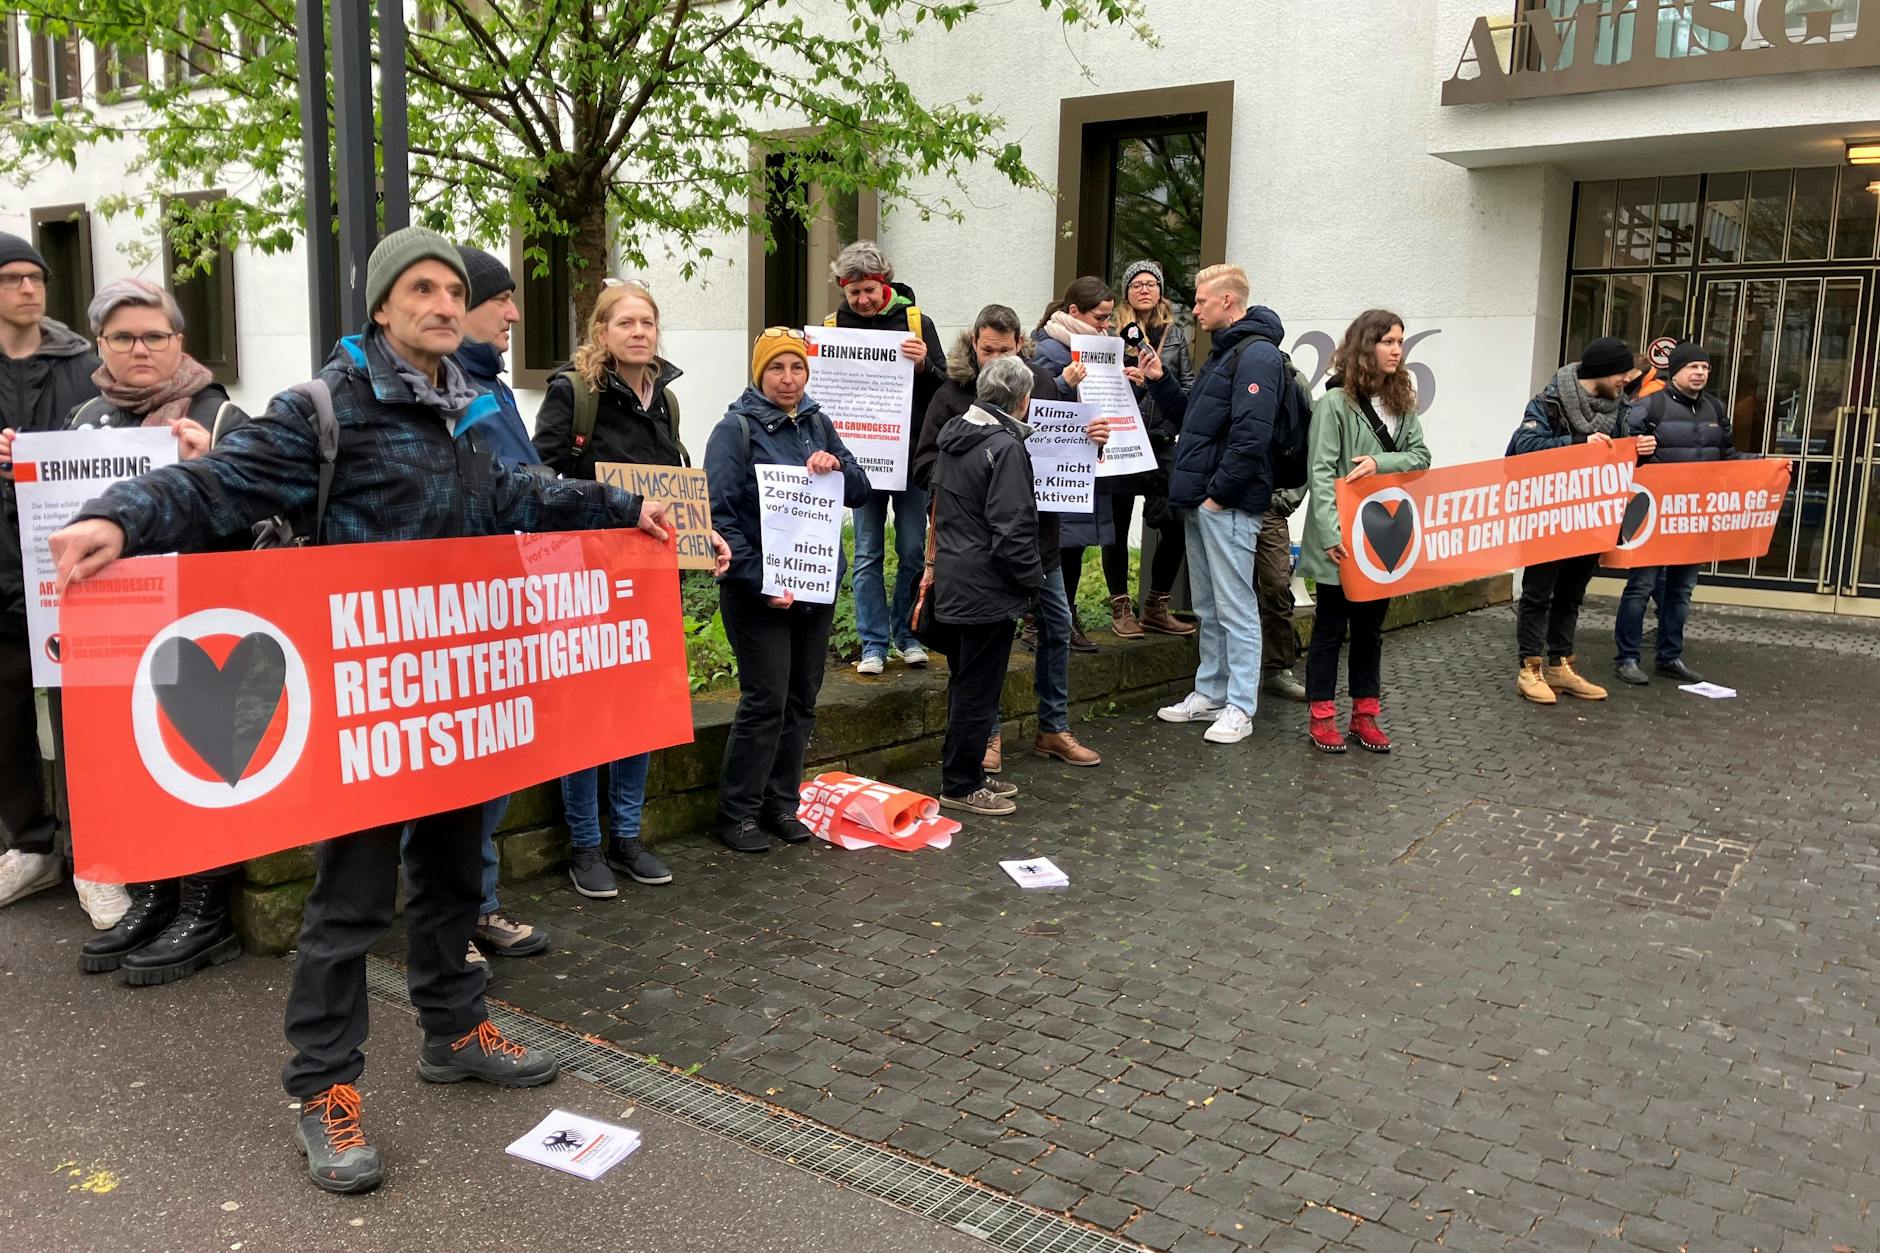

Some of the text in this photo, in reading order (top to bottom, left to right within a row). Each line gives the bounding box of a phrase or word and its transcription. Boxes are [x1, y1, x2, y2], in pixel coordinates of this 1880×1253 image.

[821, 344, 896, 362] ERINNERUNG
[1081, 351, 1116, 364] ERINNERUNG
[1034, 406, 1078, 419] Klima-
[833, 420, 901, 434] 0A GRUNDGESETZ
[1032, 422, 1088, 433] Zerstöre
[1054, 436, 1091, 446] Gericht,
[40, 456, 150, 482] ERINNERUNG
[860, 456, 894, 466] GENERATION
[1057, 462, 1091, 473] nicht
[763, 470, 813, 486] Klima-
[1046, 476, 1090, 488] Klima-
[764, 486, 836, 508] Zerstörer
[1034, 492, 1088, 504] Aktiven!
[1424, 461, 1634, 528] LETZTE GENERATION
[1660, 490, 1780, 514] ART. 20A GG =
[766, 503, 832, 524] vor's Gericht,
[1660, 509, 1780, 534] LEBEN SCHÜTZEN
[1424, 497, 1628, 562] VOR DEN KIPPPUNKTE
[794, 542, 834, 558] nicht
[766, 554, 832, 574] die Klima-
[774, 573, 830, 592] Aktiven!
[328, 568, 634, 650] KLIMANOTSTAND =
[332, 618, 652, 718] RECHTFERTIGENDER
[338, 695, 535, 784] NOTSTAND
